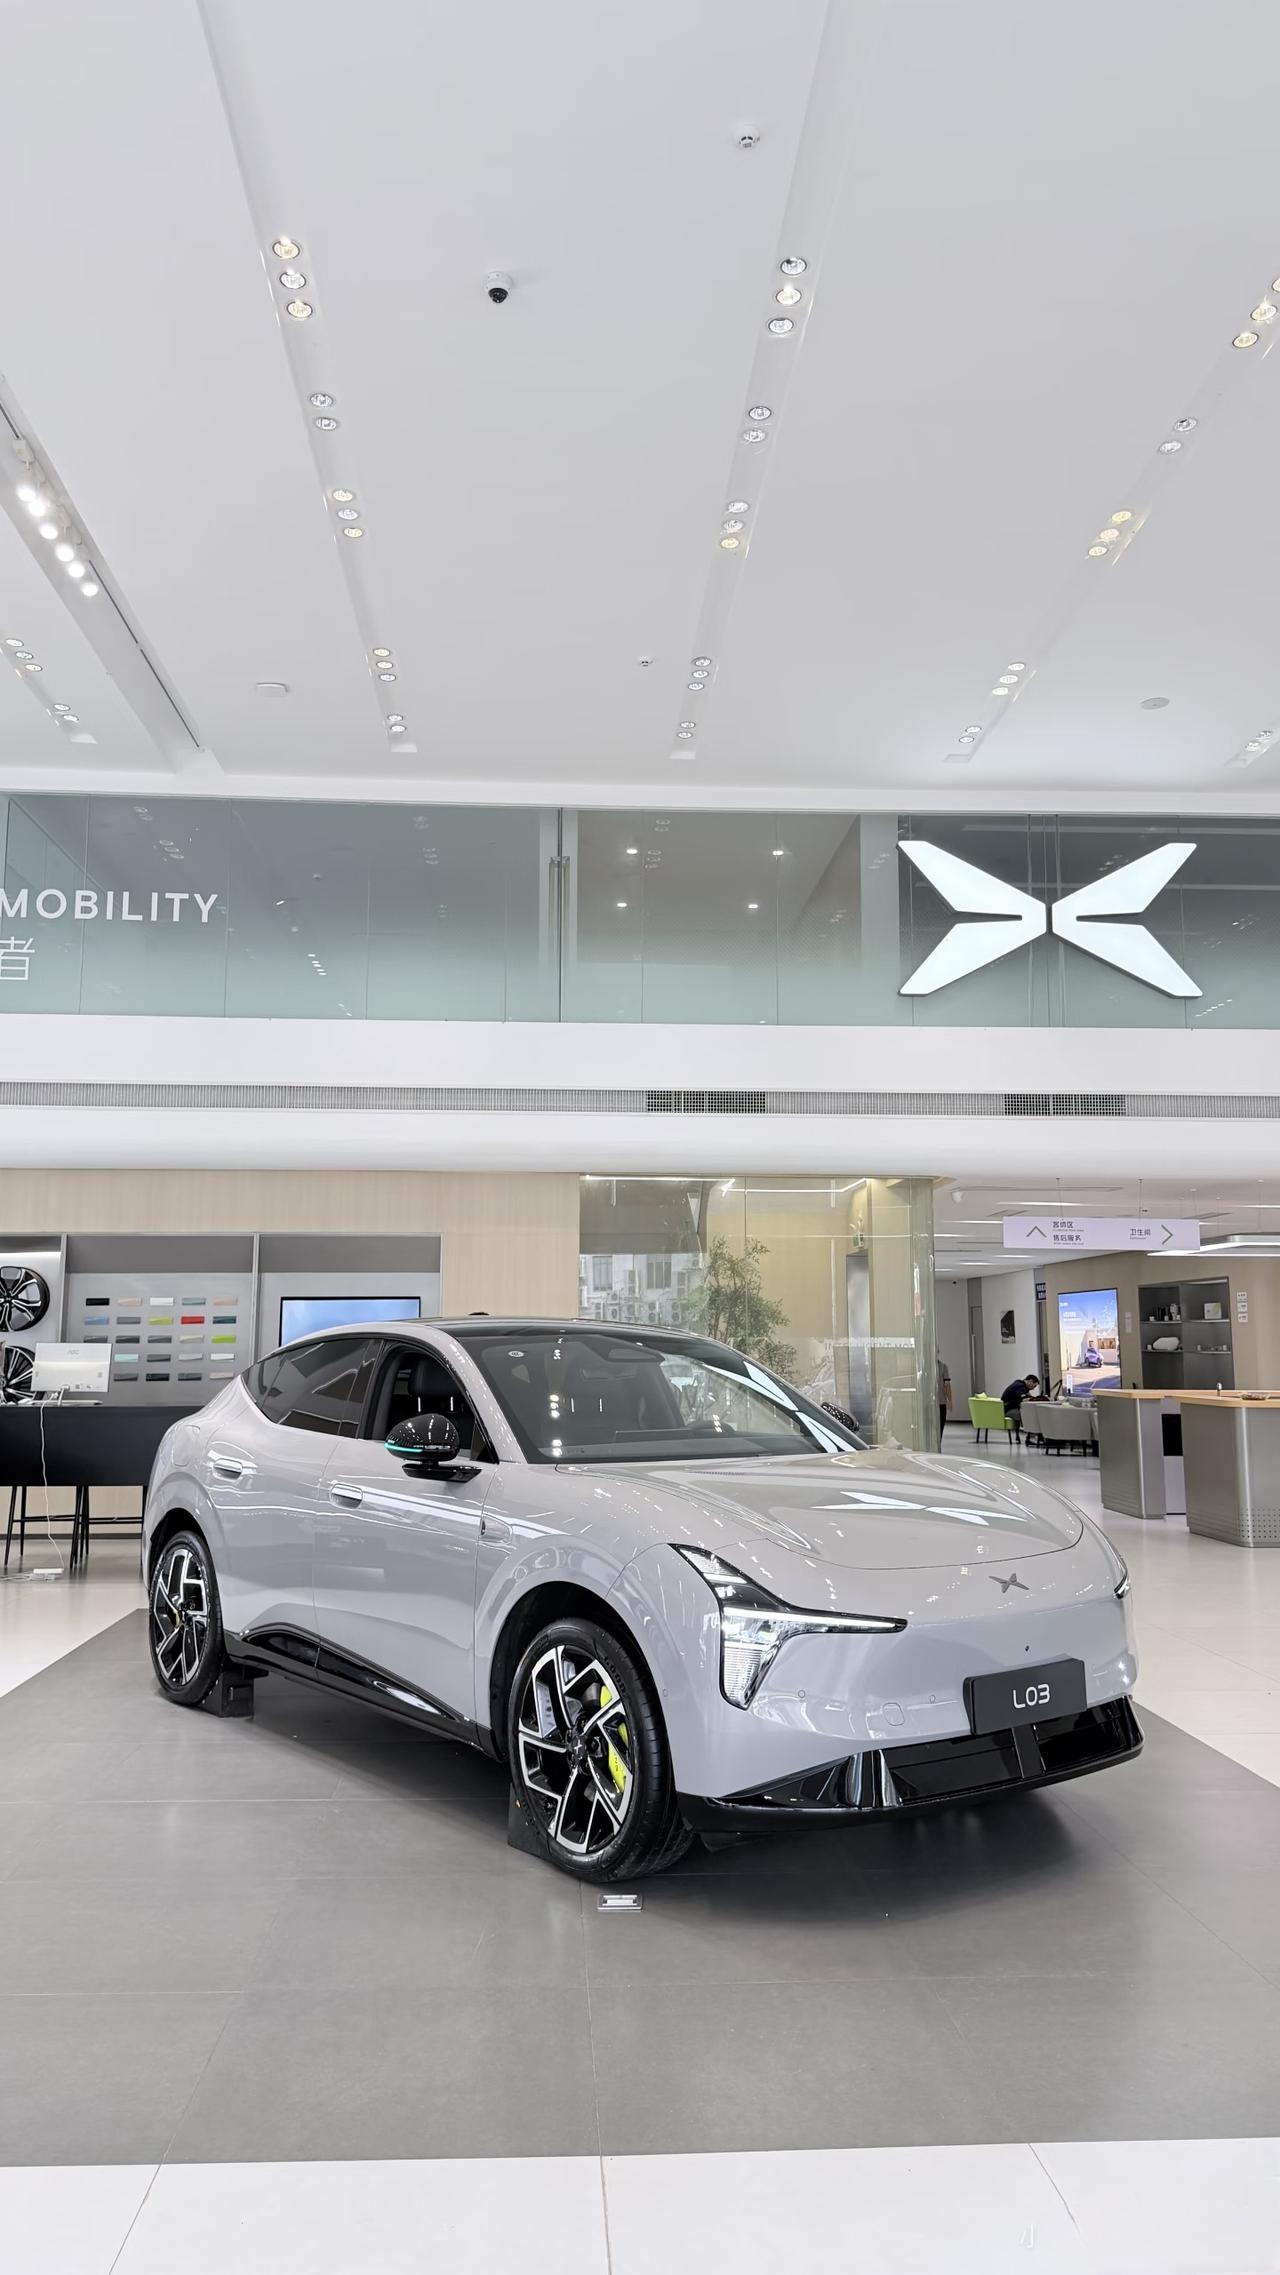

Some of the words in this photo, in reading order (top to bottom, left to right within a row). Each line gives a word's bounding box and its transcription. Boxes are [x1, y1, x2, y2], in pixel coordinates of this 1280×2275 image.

[0, 888, 218, 923] MOBILITY
[0, 936, 35, 981] 者
[1012, 1683, 1051, 1709] L03
